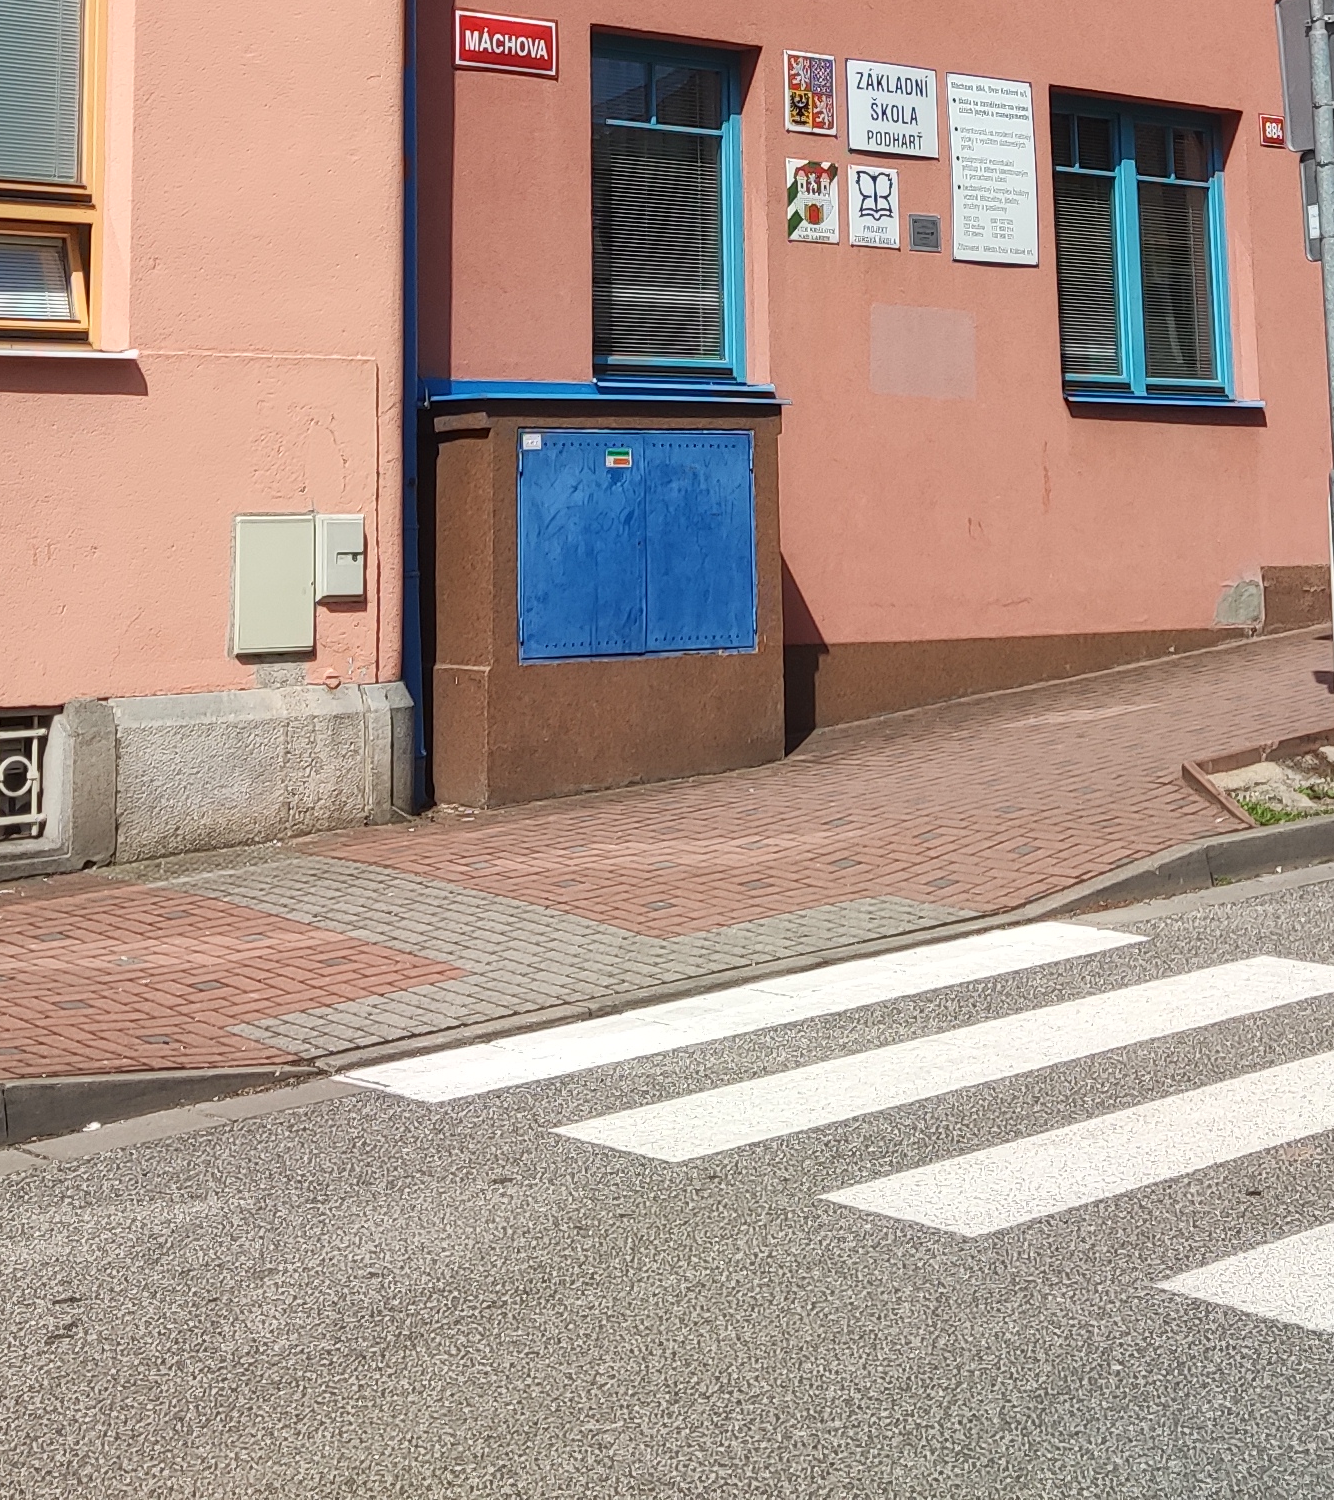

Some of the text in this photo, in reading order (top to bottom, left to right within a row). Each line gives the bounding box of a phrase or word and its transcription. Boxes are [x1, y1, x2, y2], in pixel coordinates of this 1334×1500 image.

[464, 27, 548, 60] MÁCHOVA
[855, 68, 929, 98] ZÁKLADNÍ
[870, 97, 918, 126] ŠKOLA
[867, 129, 923, 151] PODHARŤ
[1266, 121, 1283, 140] 884
